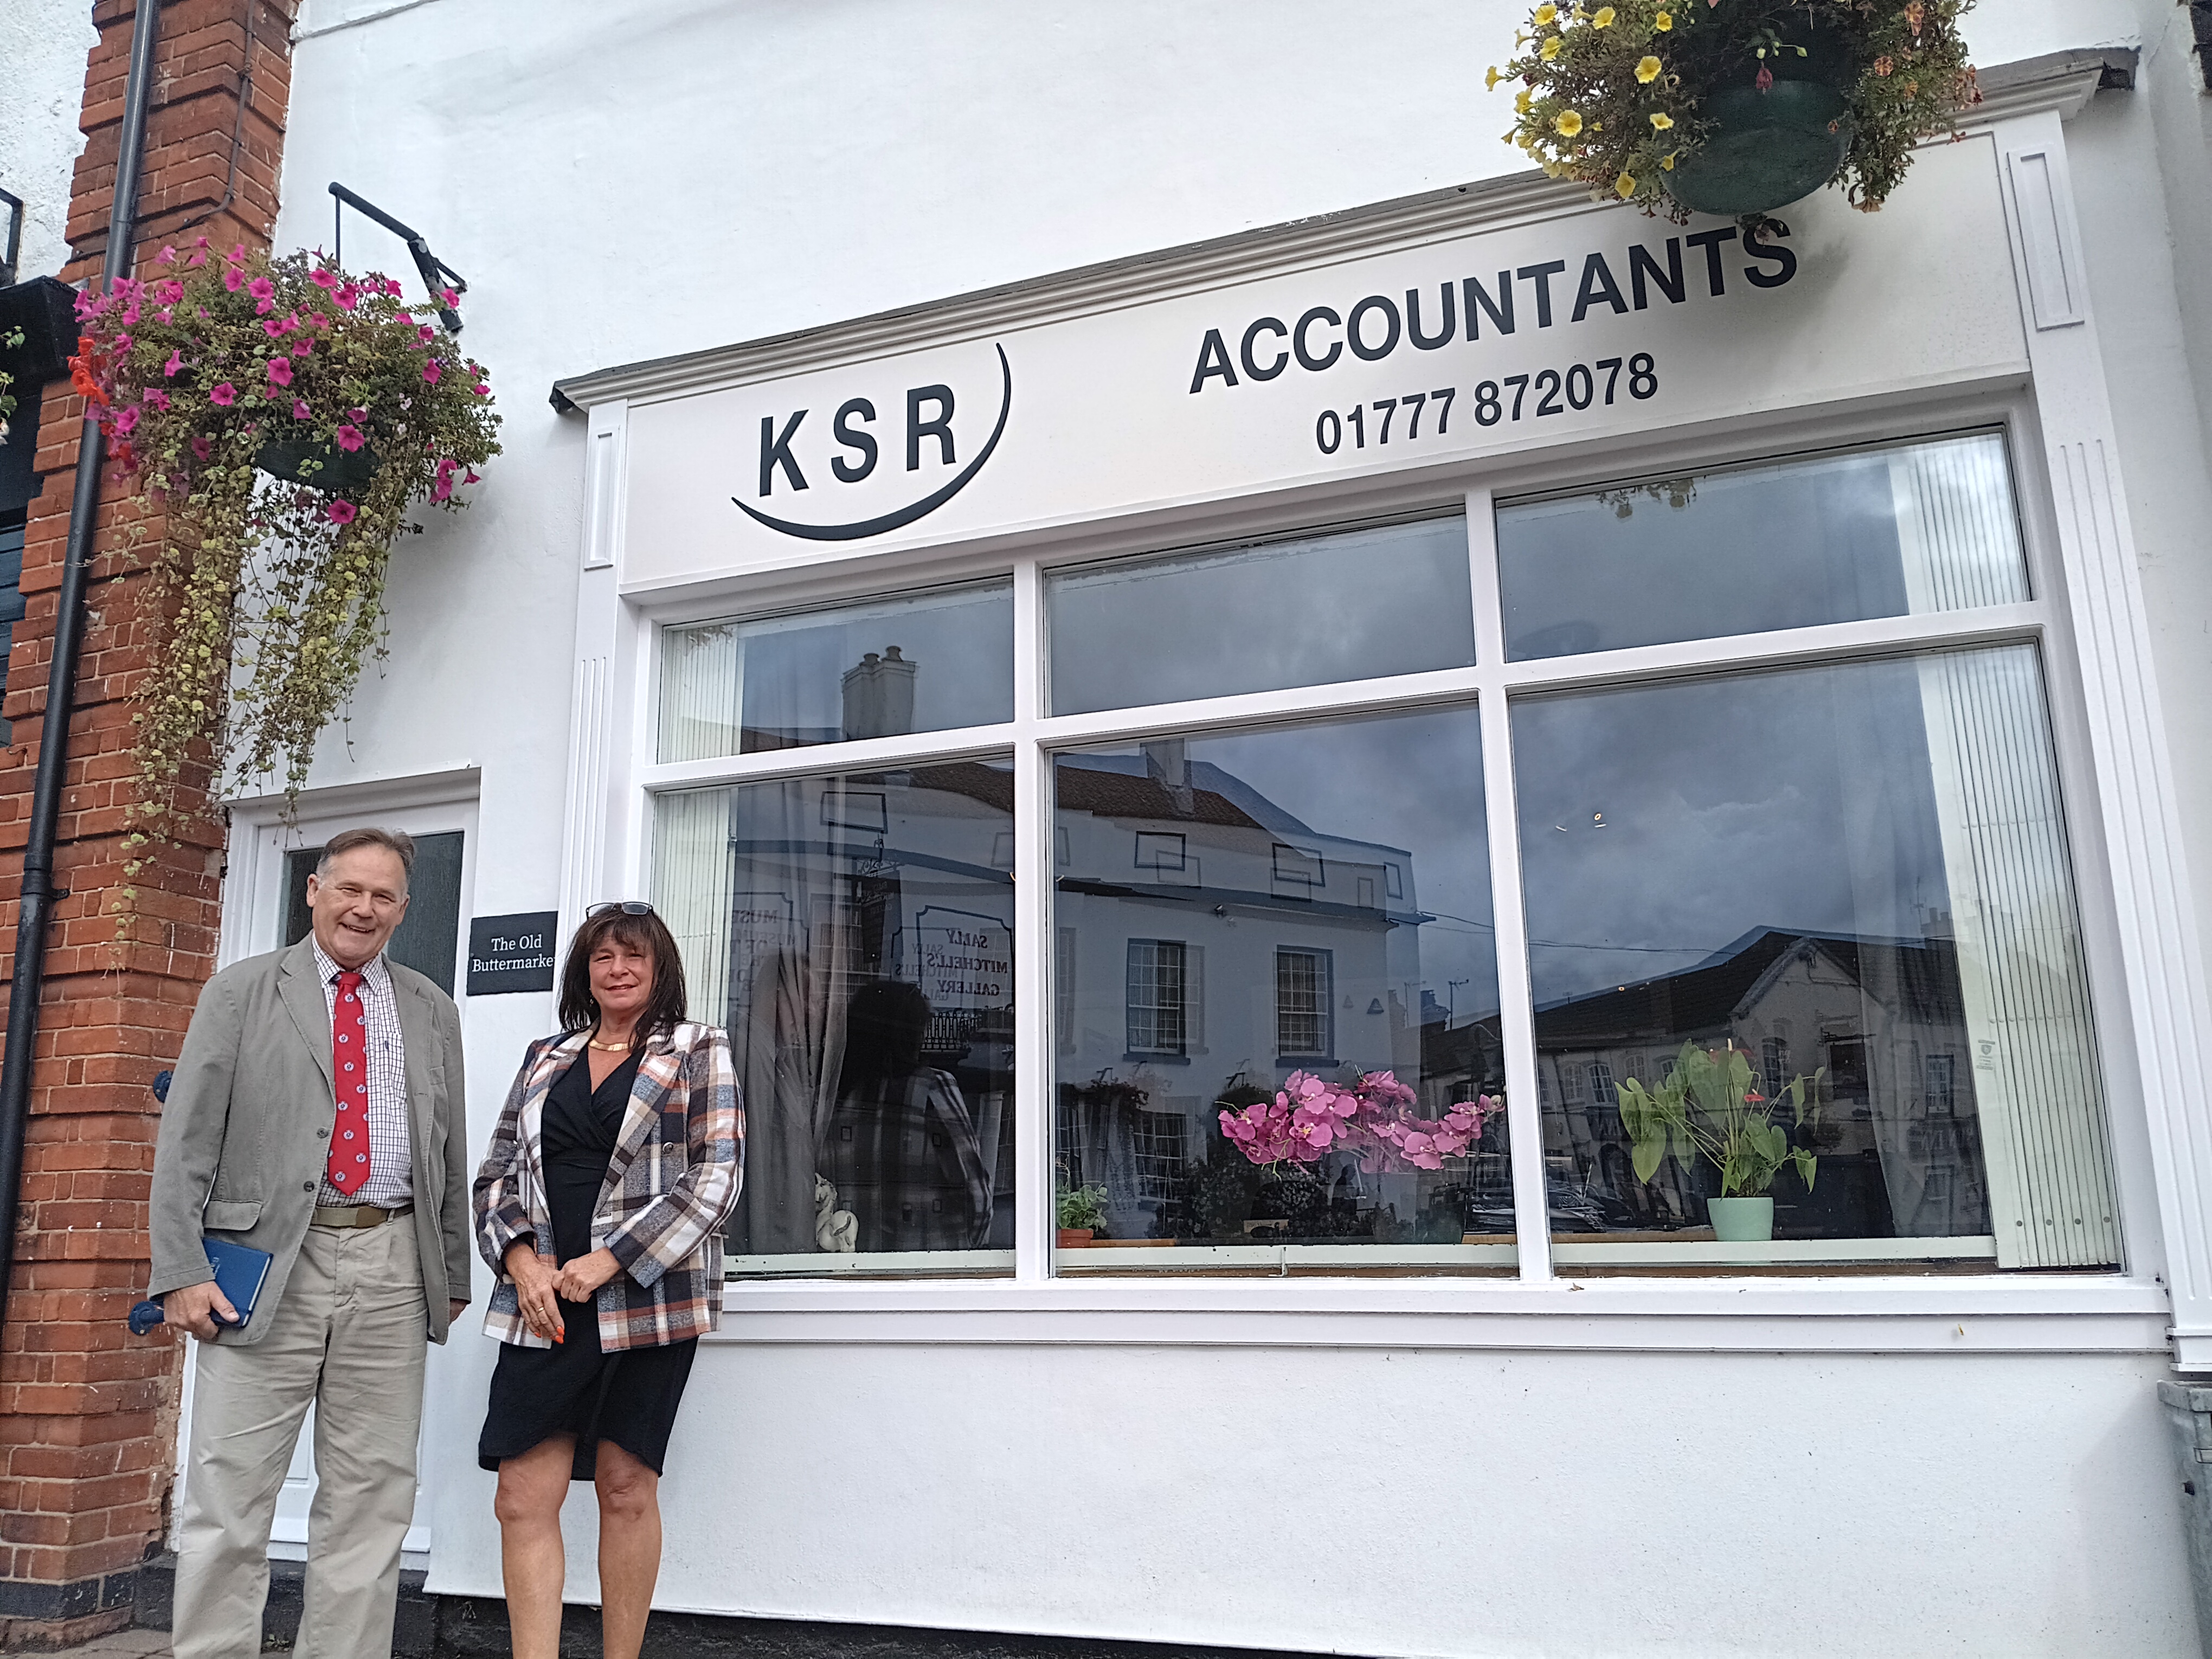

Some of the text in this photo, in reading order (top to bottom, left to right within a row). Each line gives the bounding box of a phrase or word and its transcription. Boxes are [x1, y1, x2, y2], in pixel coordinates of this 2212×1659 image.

[1189, 218, 1797, 394] ACCOUNTANTS
[760, 384, 956, 497] KSR
[1317, 353, 1657, 454] 01777 872078
[491, 934, 542, 951] The Old
